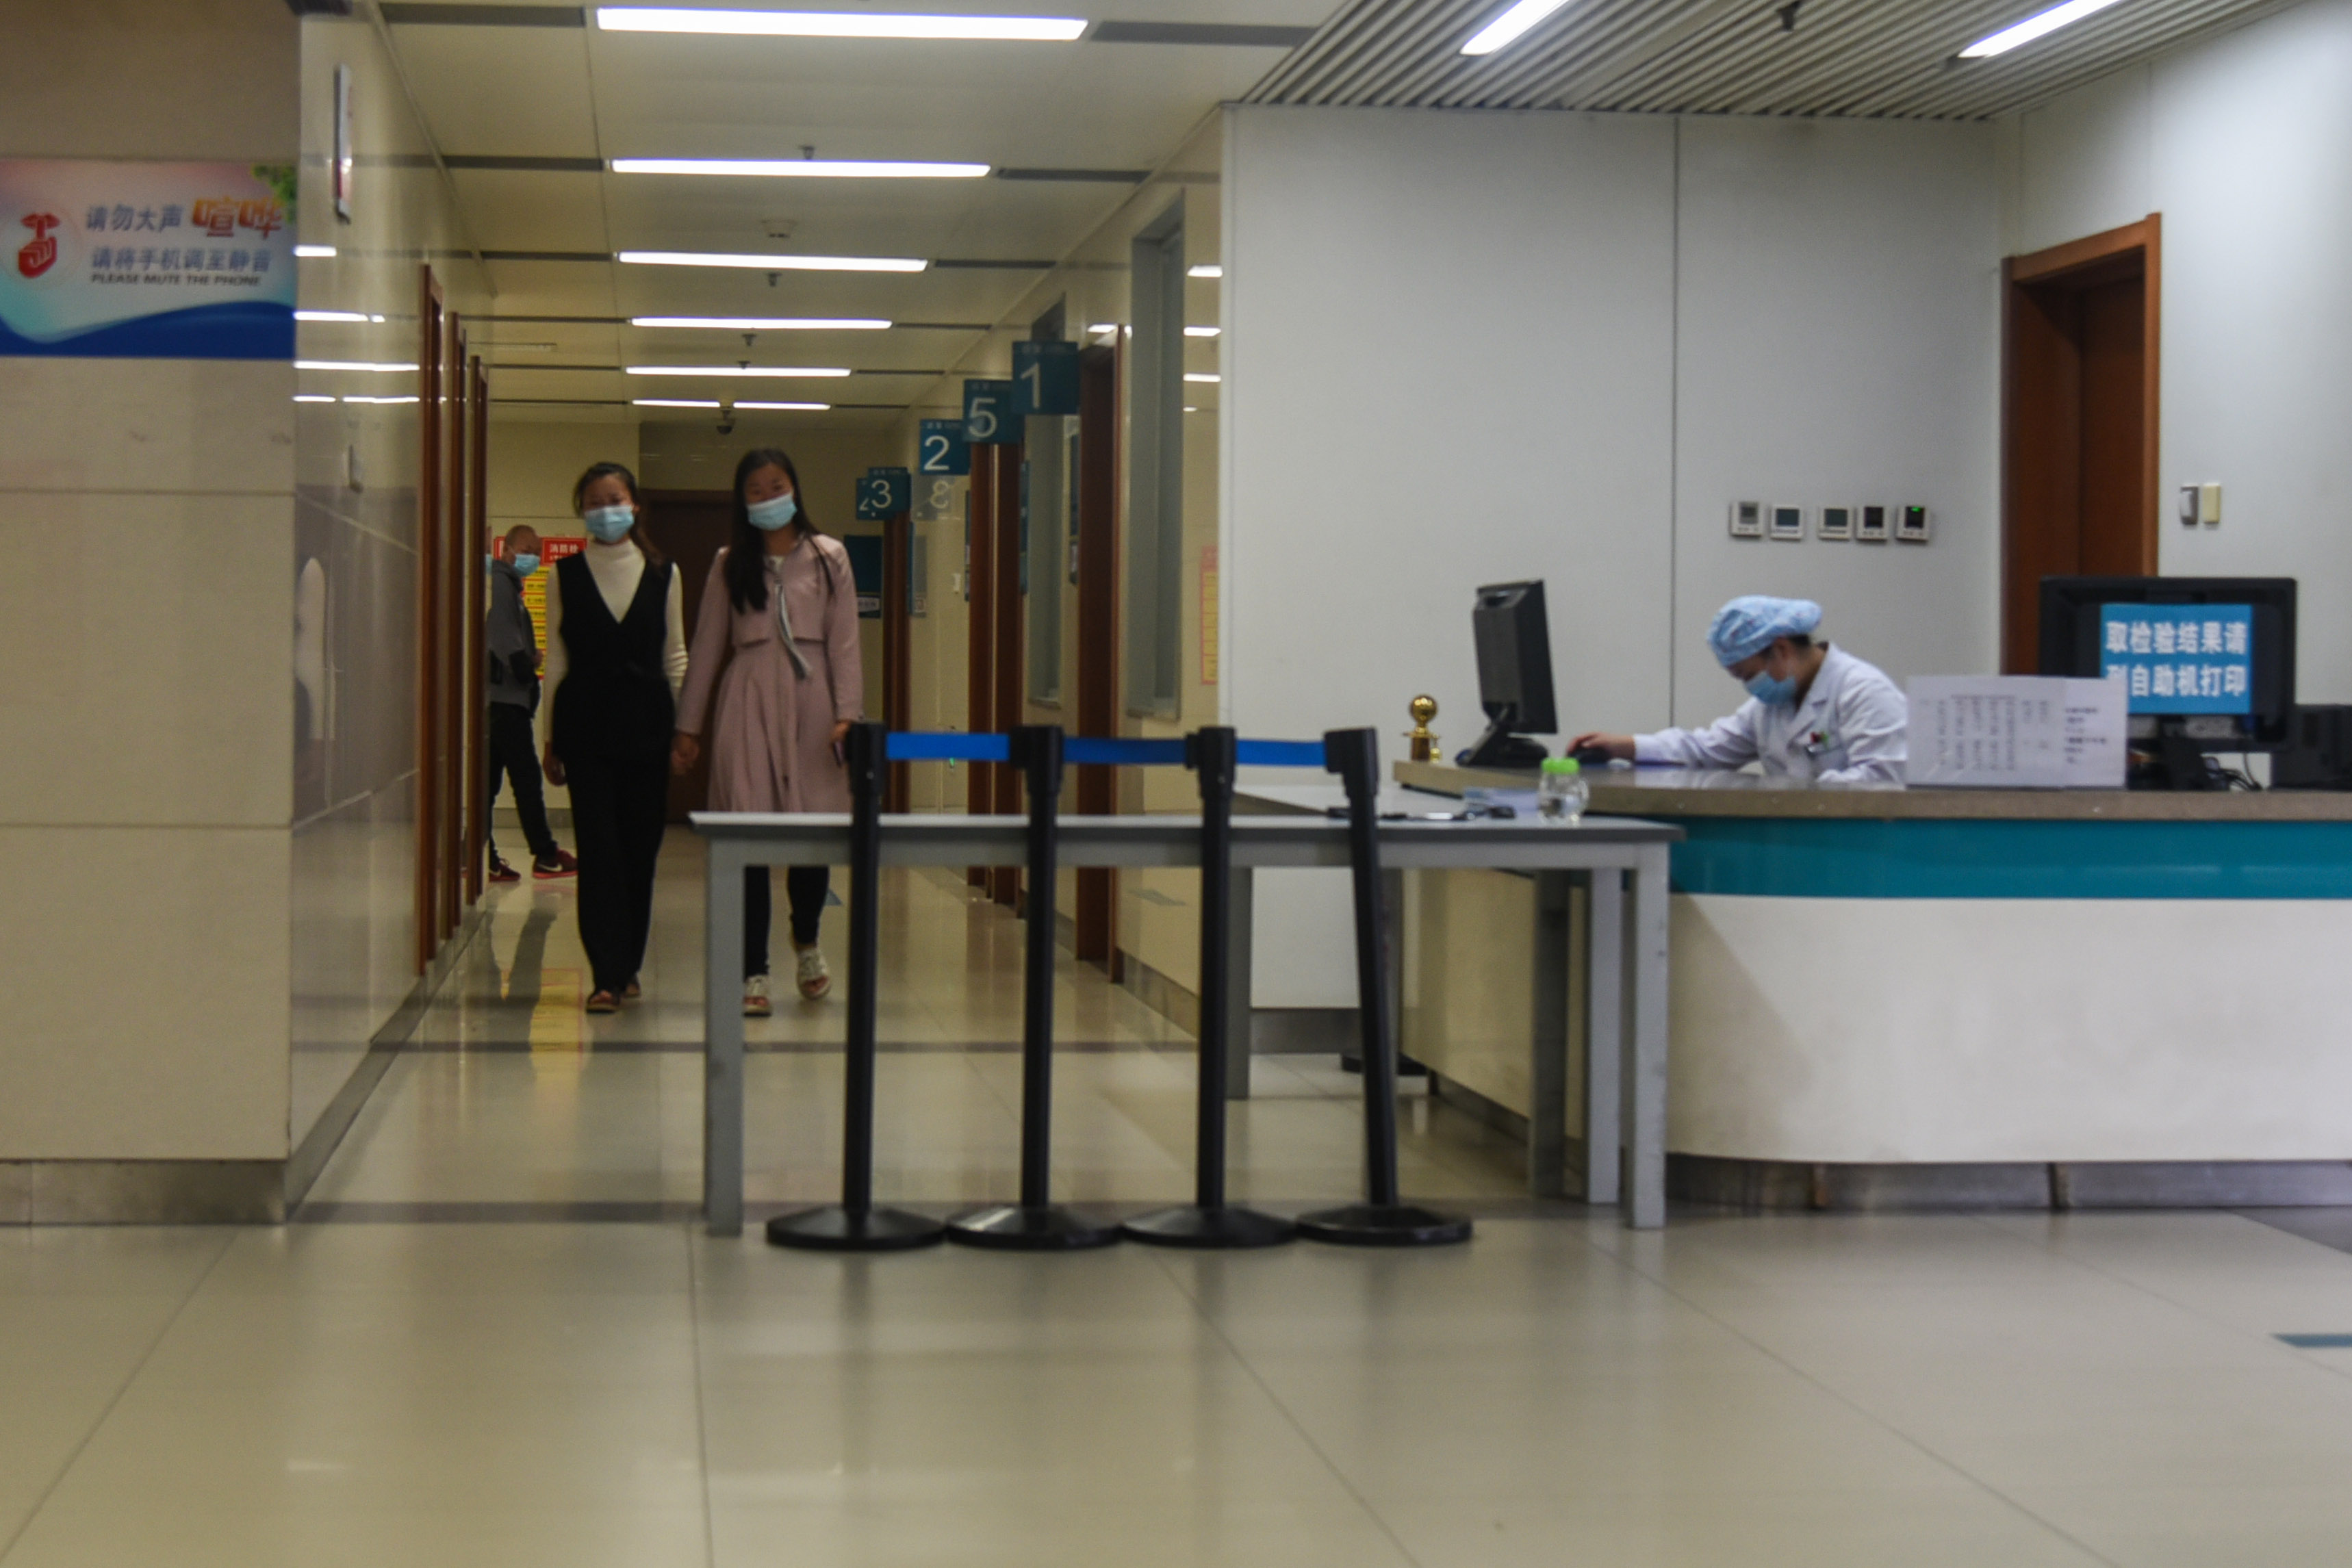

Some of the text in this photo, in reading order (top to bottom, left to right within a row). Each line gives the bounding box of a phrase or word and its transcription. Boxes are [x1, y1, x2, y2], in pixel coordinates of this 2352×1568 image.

[87, 196, 283, 239] 请勿大声 喧哗
[92, 246, 272, 272] 请将手机调至静音
[91, 274, 261, 286] PLEASE MUTE THE PHONE
[1020, 362, 1041, 409] 1
[968, 397, 997, 438] 5
[923, 435, 950, 471] 2
[871, 479, 892, 509] 3
[2106, 621, 2247, 654] 取检验结果请
